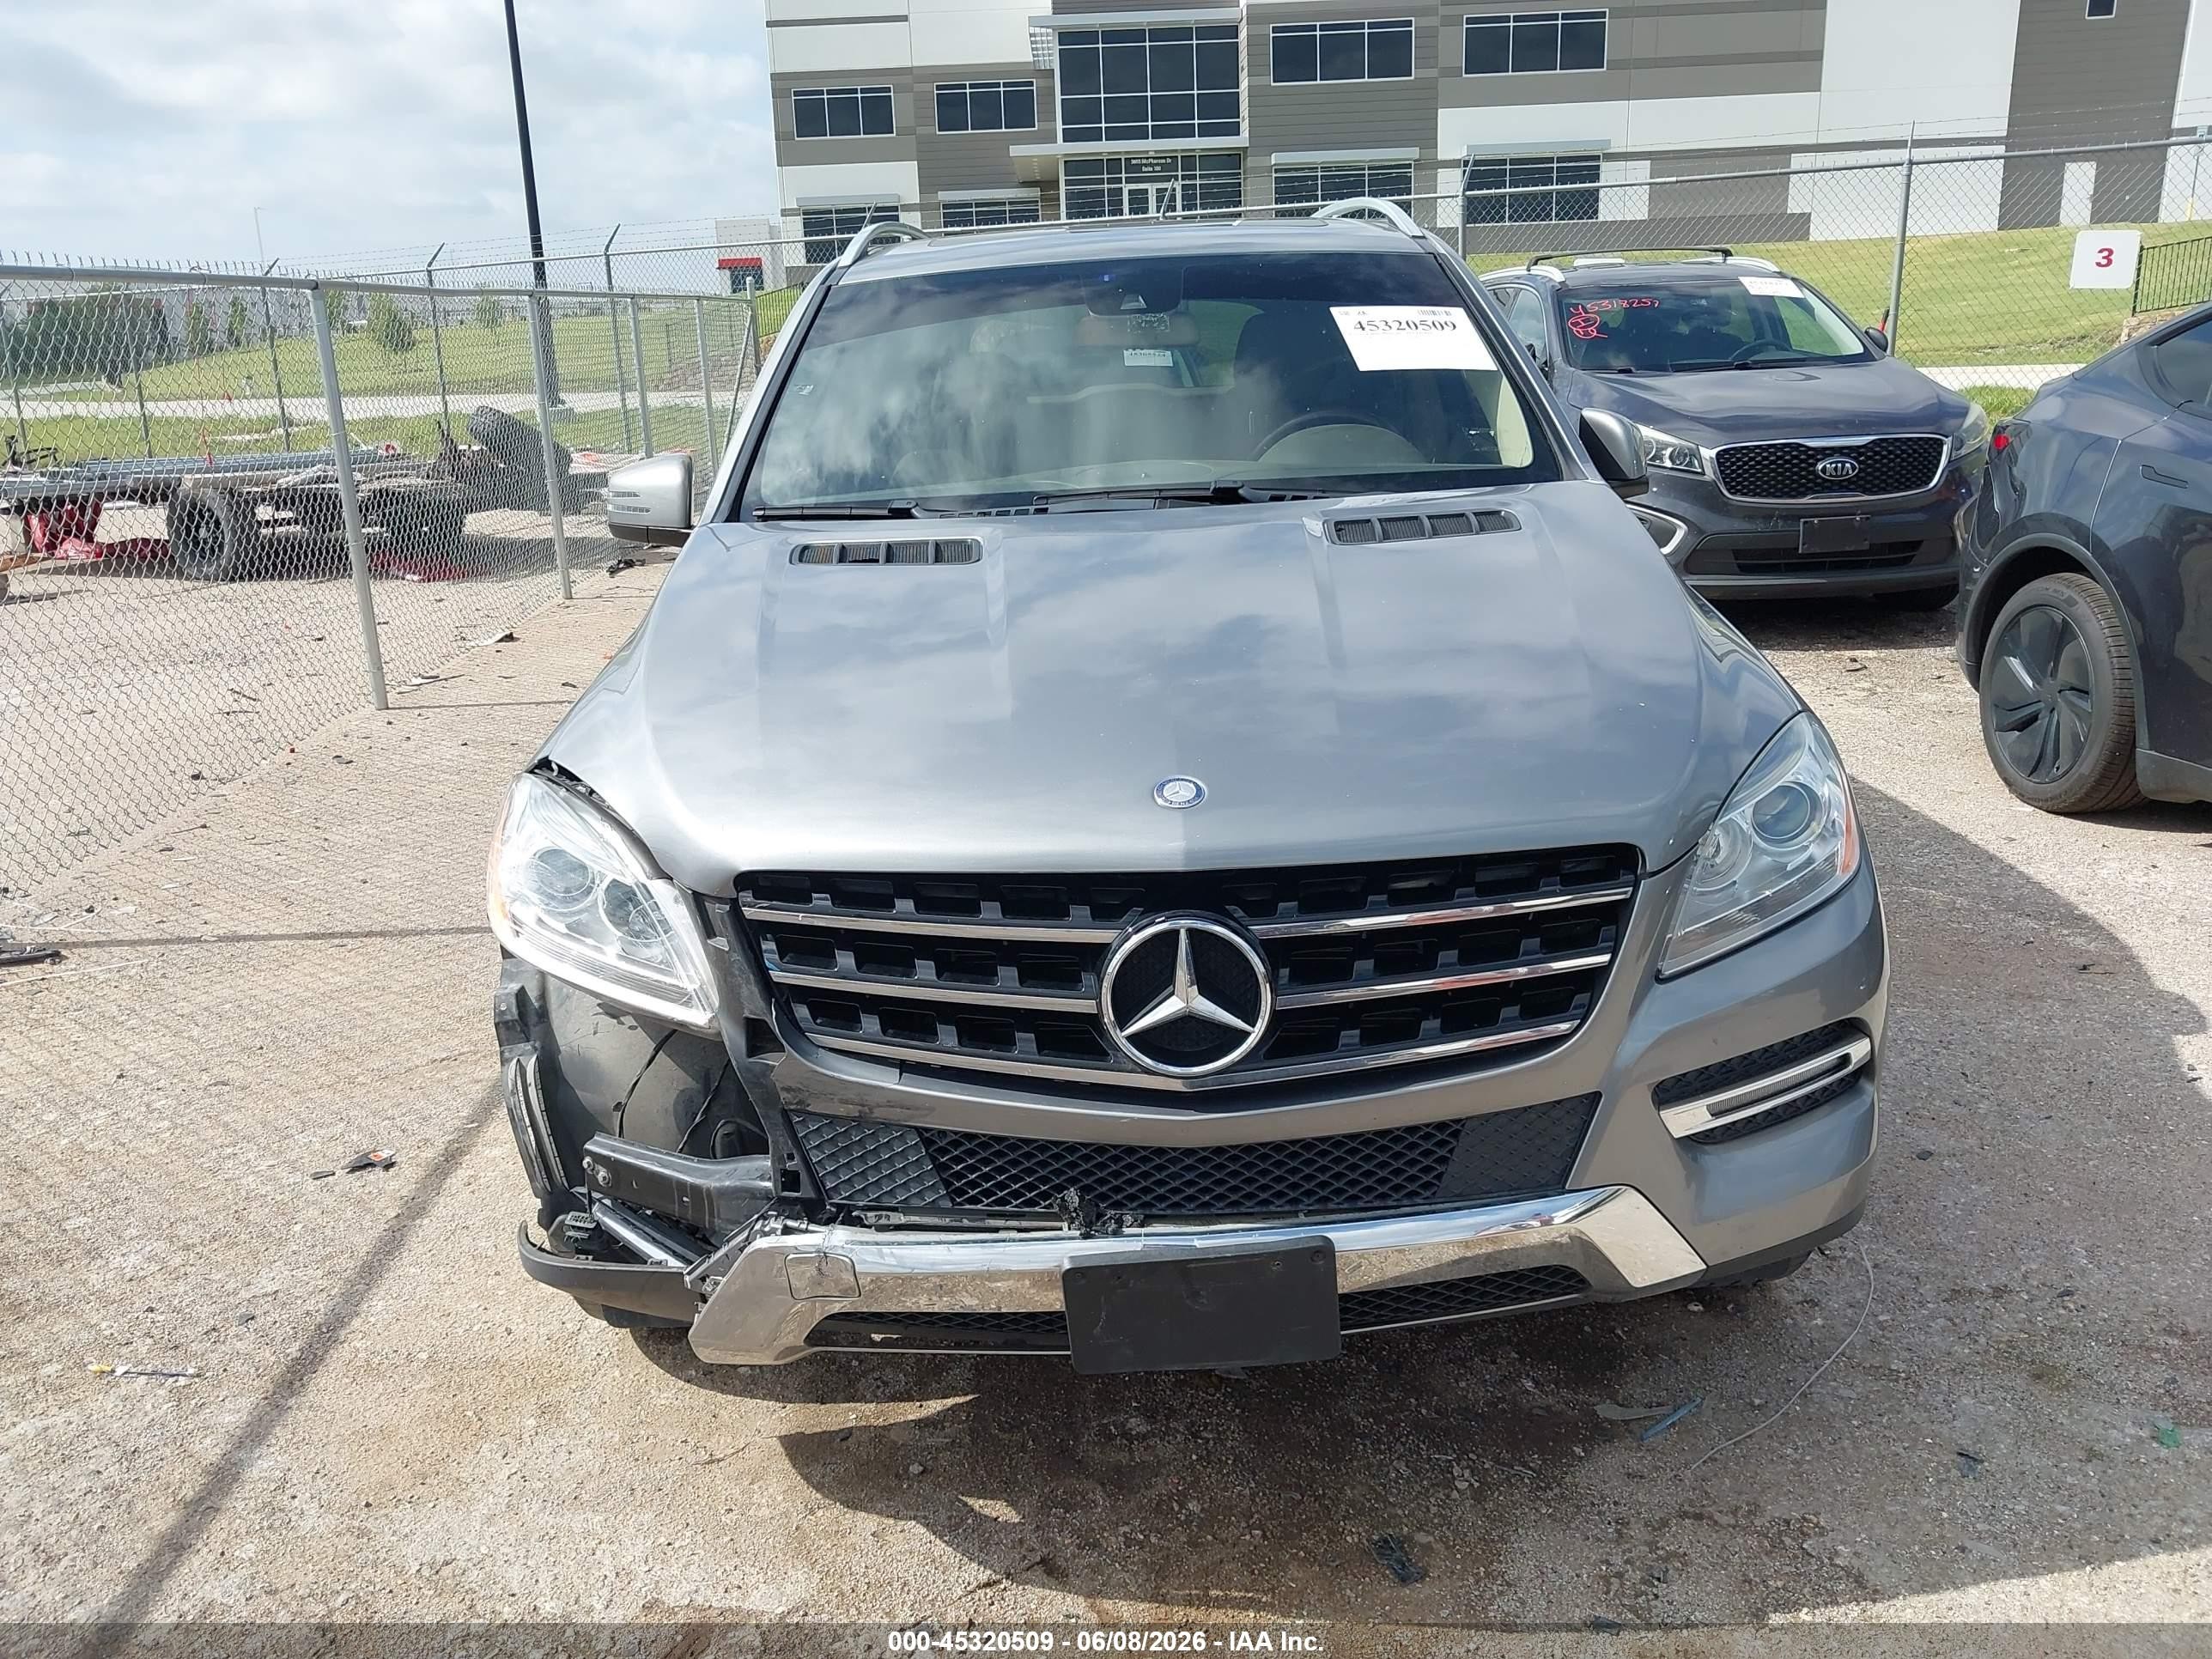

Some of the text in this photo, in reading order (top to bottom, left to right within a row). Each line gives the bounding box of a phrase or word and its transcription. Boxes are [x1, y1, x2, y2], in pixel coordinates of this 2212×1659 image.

[2094, 247, 2115, 268] 3
[1353, 319, 1458, 332] 45320509
[1825, 463, 1853, 476] KIA
